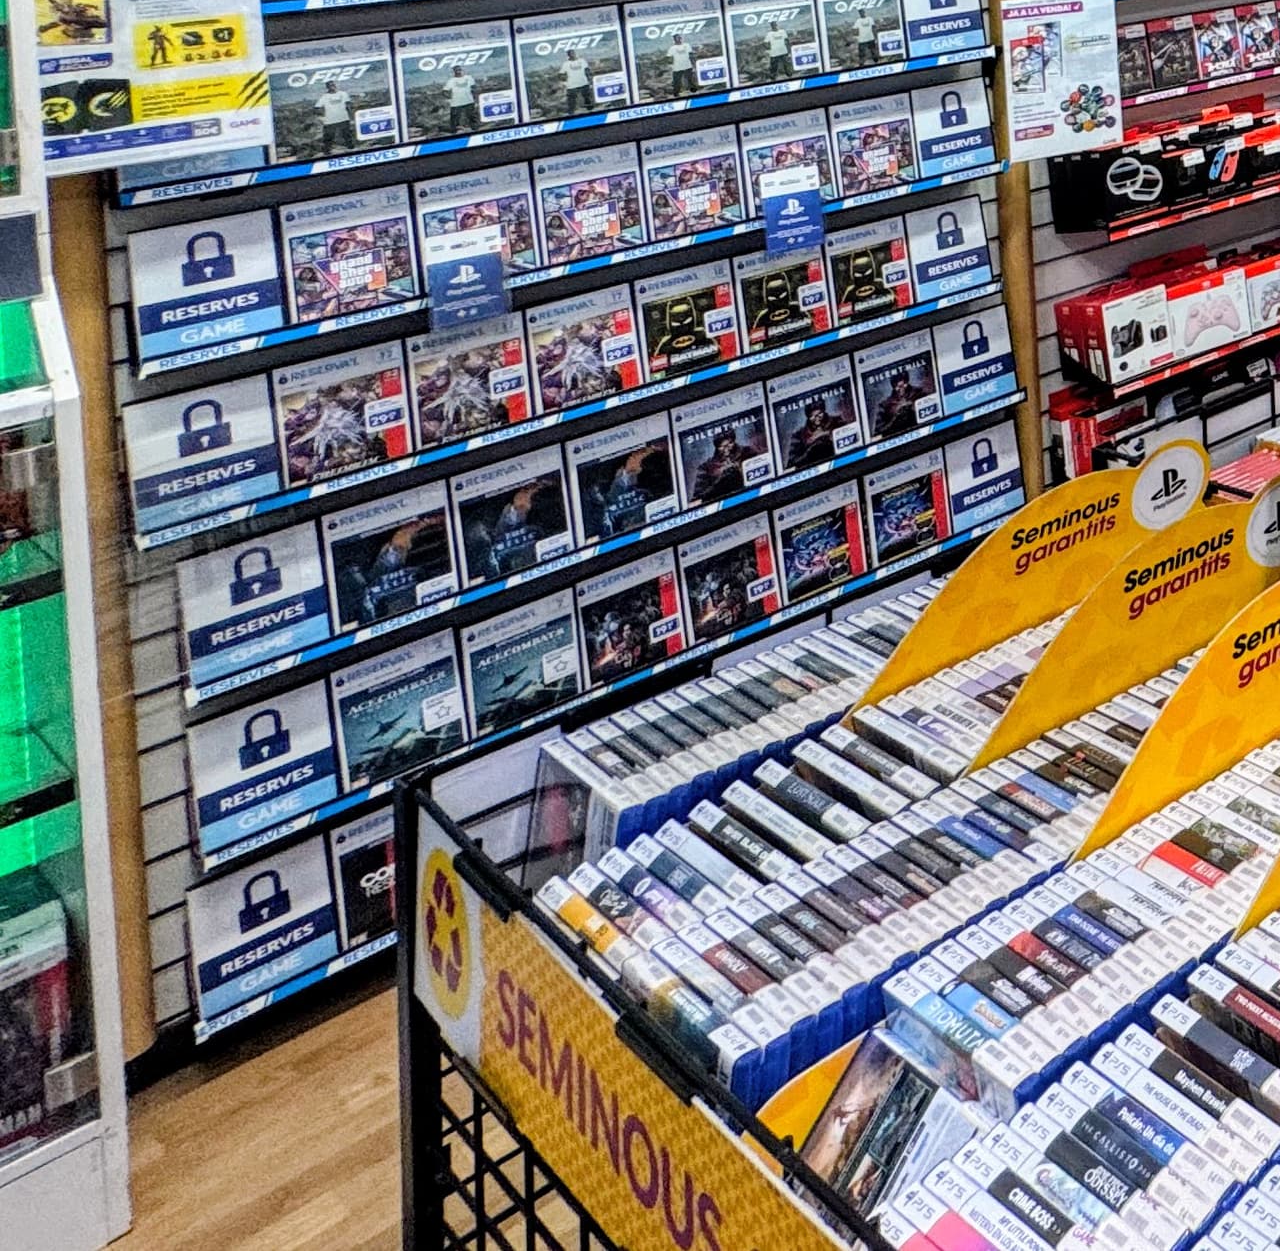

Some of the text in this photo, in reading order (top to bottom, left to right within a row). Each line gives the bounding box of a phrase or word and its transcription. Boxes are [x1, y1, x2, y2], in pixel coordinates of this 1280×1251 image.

[327, 150, 402, 168] RESERVES
[160, 290, 260, 324] RESERVES
[180, 317, 248, 344] GAME
[953, 362, 1004, 386] RESERVES
[158, 459, 256, 496] RESERVES
[1010, 489, 1121, 551] Seminous
[1014, 512, 1117, 575] garantits
[219, 764, 314, 812] RESERVES
[237, 793, 303, 831] GAME
[219, 921, 315, 975] RESERVES
[1083, 1169, 1129, 1209] ODYSSEY
[1008, 1188, 1054, 1230] CRIME BOSS
